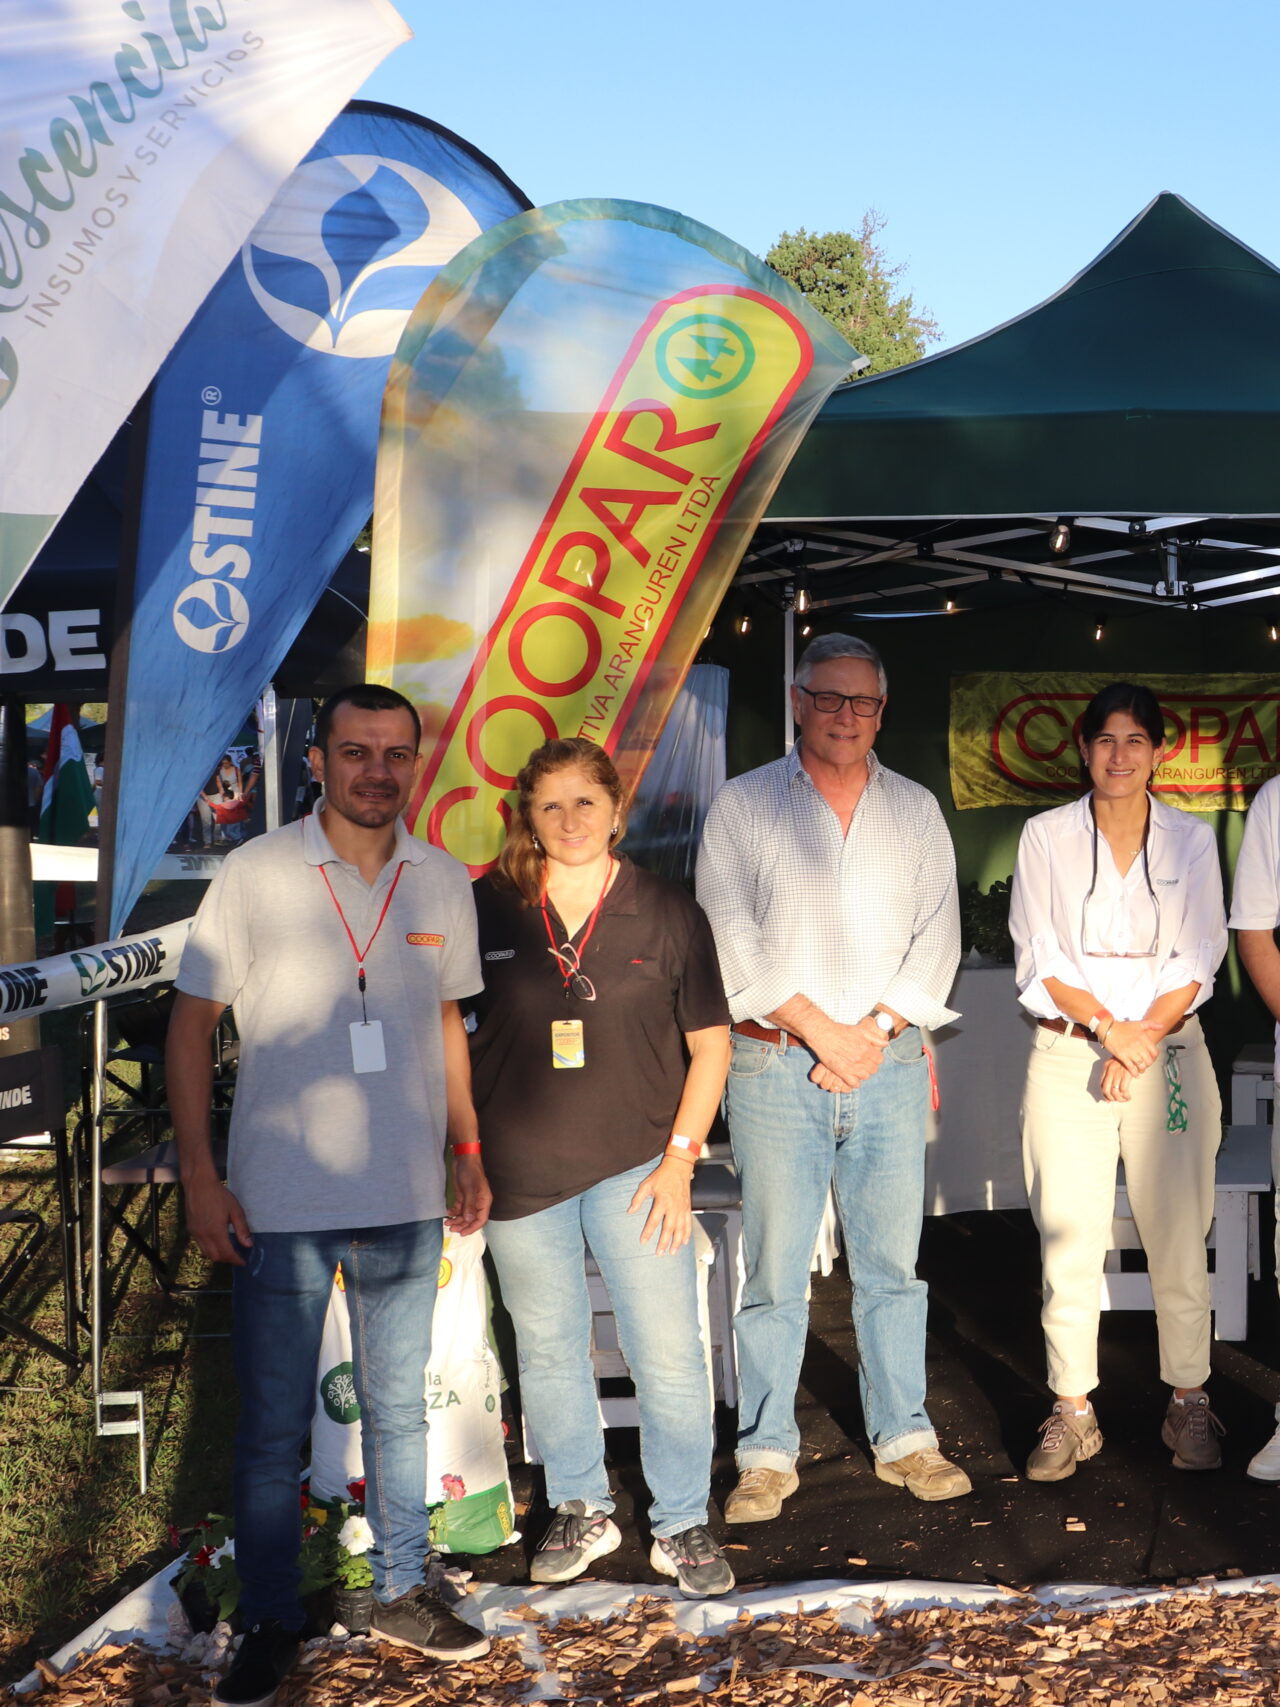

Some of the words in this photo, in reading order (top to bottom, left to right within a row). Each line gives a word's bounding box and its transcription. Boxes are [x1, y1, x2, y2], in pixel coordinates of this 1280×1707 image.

[24, 187, 129, 328] INSUMOS
[135, 30, 265, 166] SERVICIOS
[604, 536, 687, 691] ARANGUREN
[677, 475, 721, 534] LTDA
[1152, 767, 1246, 780] ARANGUREN
[101, 937, 166, 988] STINE
[0, 966, 48, 1014] INE
